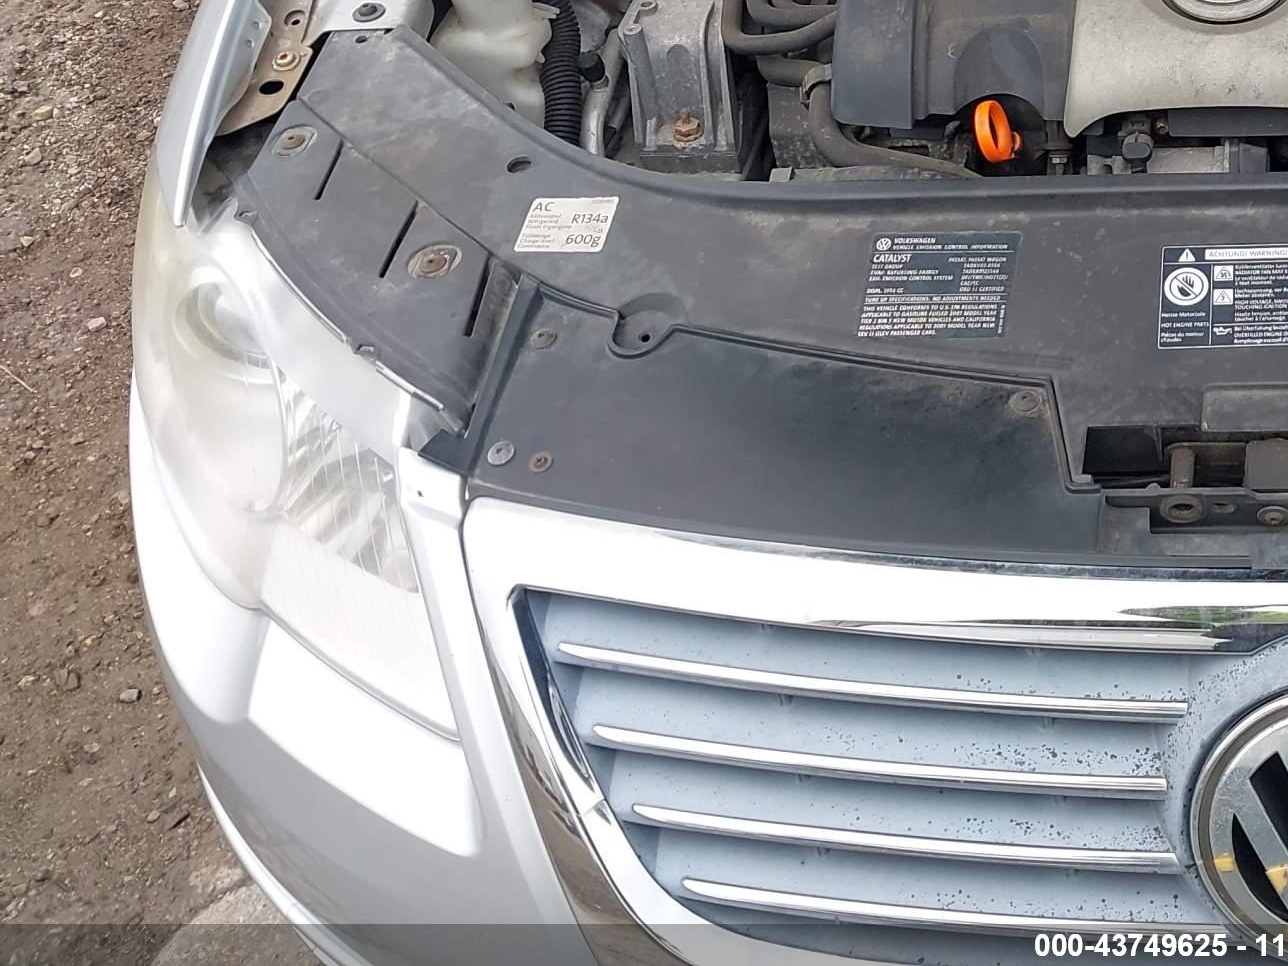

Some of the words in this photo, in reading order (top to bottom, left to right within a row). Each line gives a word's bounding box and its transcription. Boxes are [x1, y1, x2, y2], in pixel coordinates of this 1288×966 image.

[532, 201, 555, 212] AC
[571, 213, 609, 224] R134a
[565, 234, 602, 247] 600g
[873, 254, 913, 263] CATALYST
